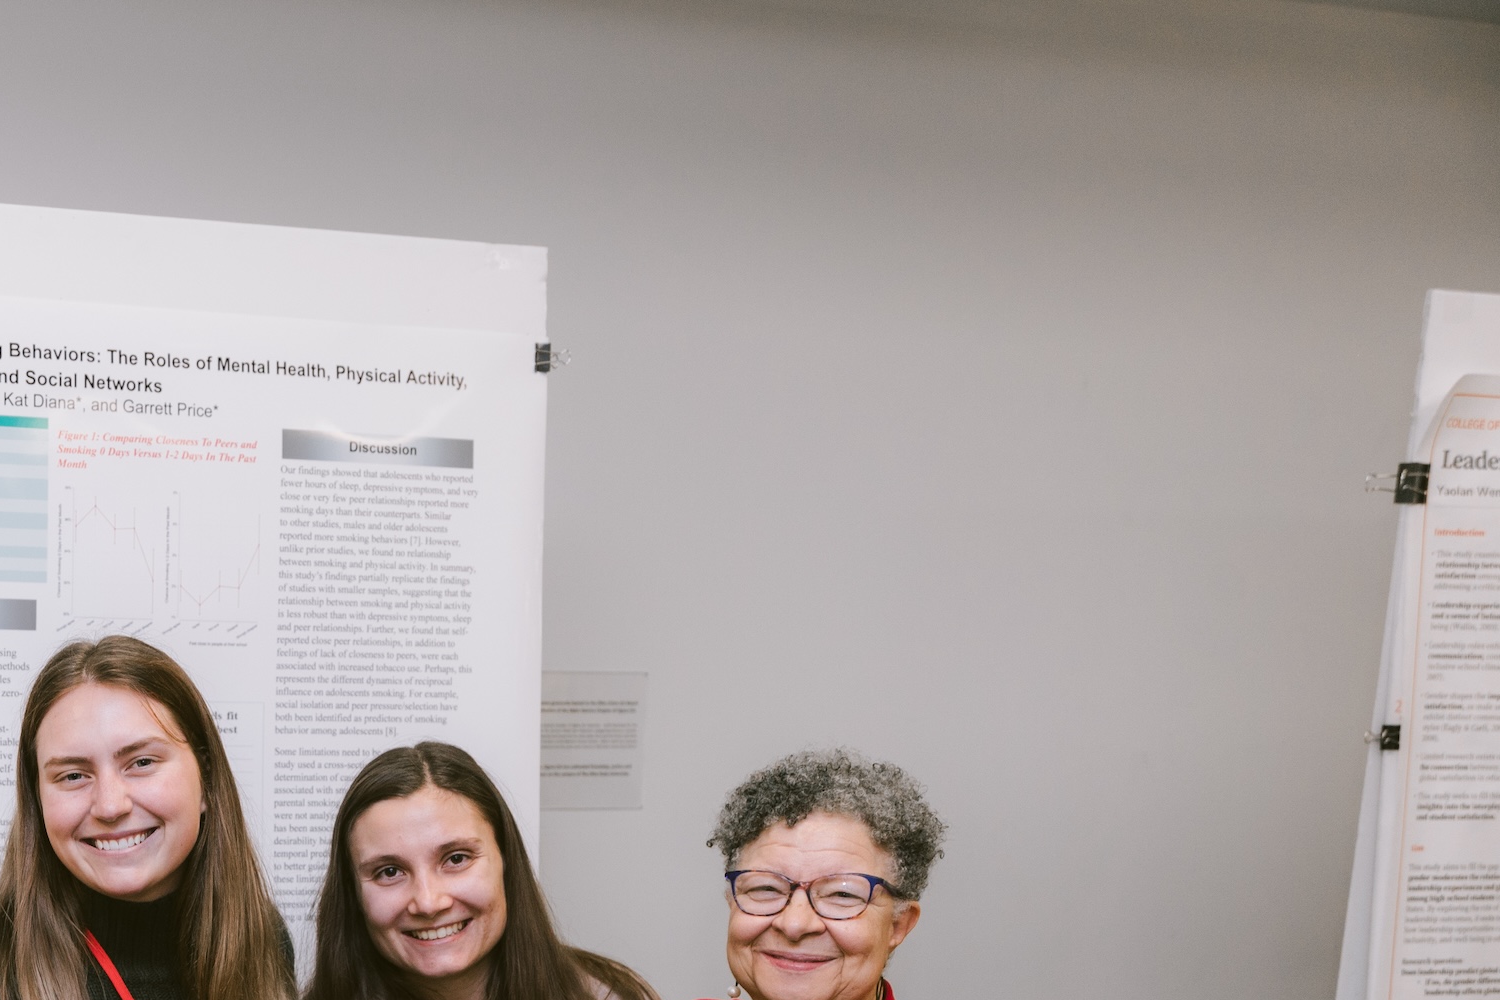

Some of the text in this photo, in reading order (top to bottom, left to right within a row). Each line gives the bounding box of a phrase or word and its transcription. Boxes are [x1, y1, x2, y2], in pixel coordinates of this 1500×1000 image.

[10, 344, 101, 363] Behaviors:
[108, 349, 137, 365] The
[144, 352, 190, 369] Roles
[196, 356, 212, 370] of
[218, 357, 270, 374] Mental
[276, 362, 331, 381] Health,
[336, 366, 401, 384] Physical
[406, 371, 467, 390] Activity,
[26, 371, 77, 387] Social
[85, 374, 162, 392] Networks
[4, 389, 28, 407] Kat
[91, 398, 117, 412] and
[123, 400, 172, 416] Garrett
[1446, 419, 1485, 430] COLLEGE
[58, 431, 257, 449] Figure 1: Comparing Closeness To Peers and
[350, 441, 417, 456] Discussion
